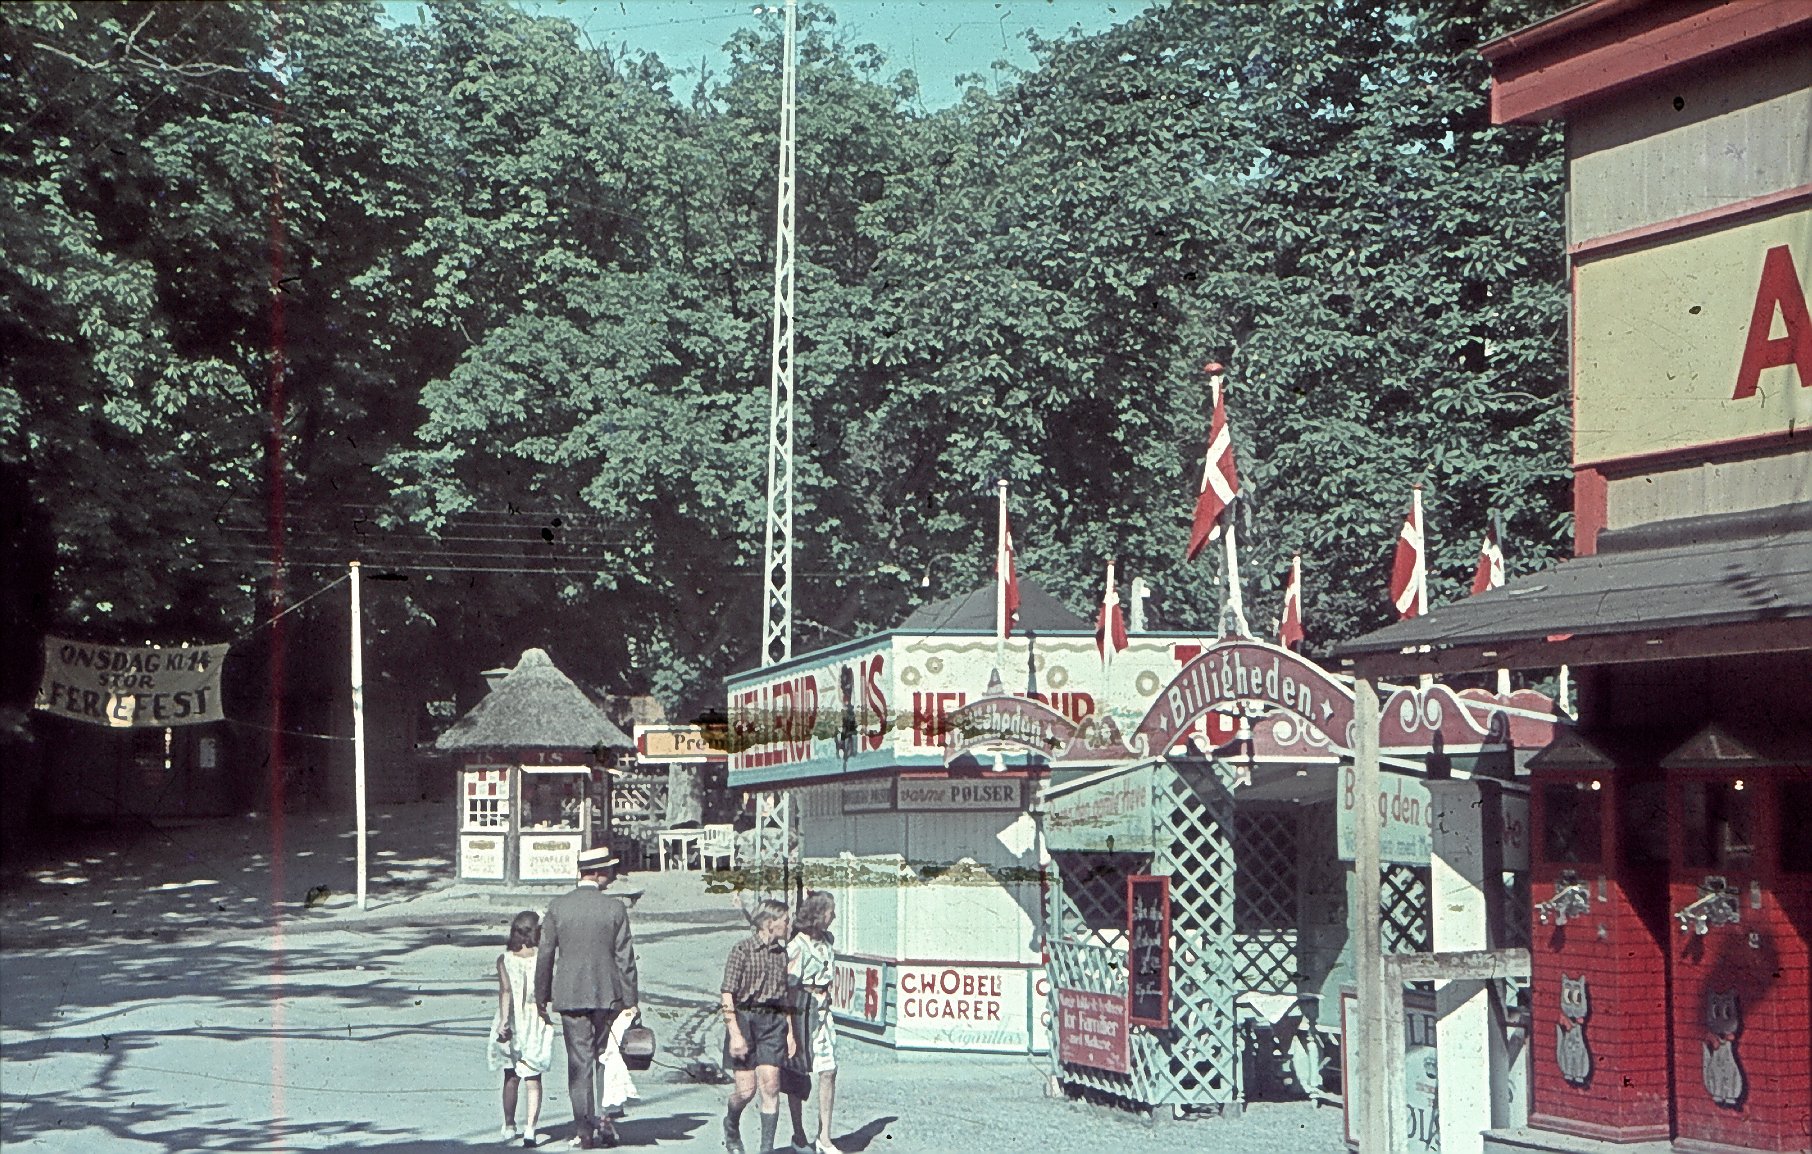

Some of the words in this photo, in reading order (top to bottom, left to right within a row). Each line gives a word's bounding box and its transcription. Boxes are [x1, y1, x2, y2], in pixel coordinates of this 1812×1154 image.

[60, 645, 161, 673] ONSDAG
[100, 673, 155, 690] STOR
[50, 682, 212, 721] FERIEFEST
[904, 998, 1001, 1021] CIGARER
